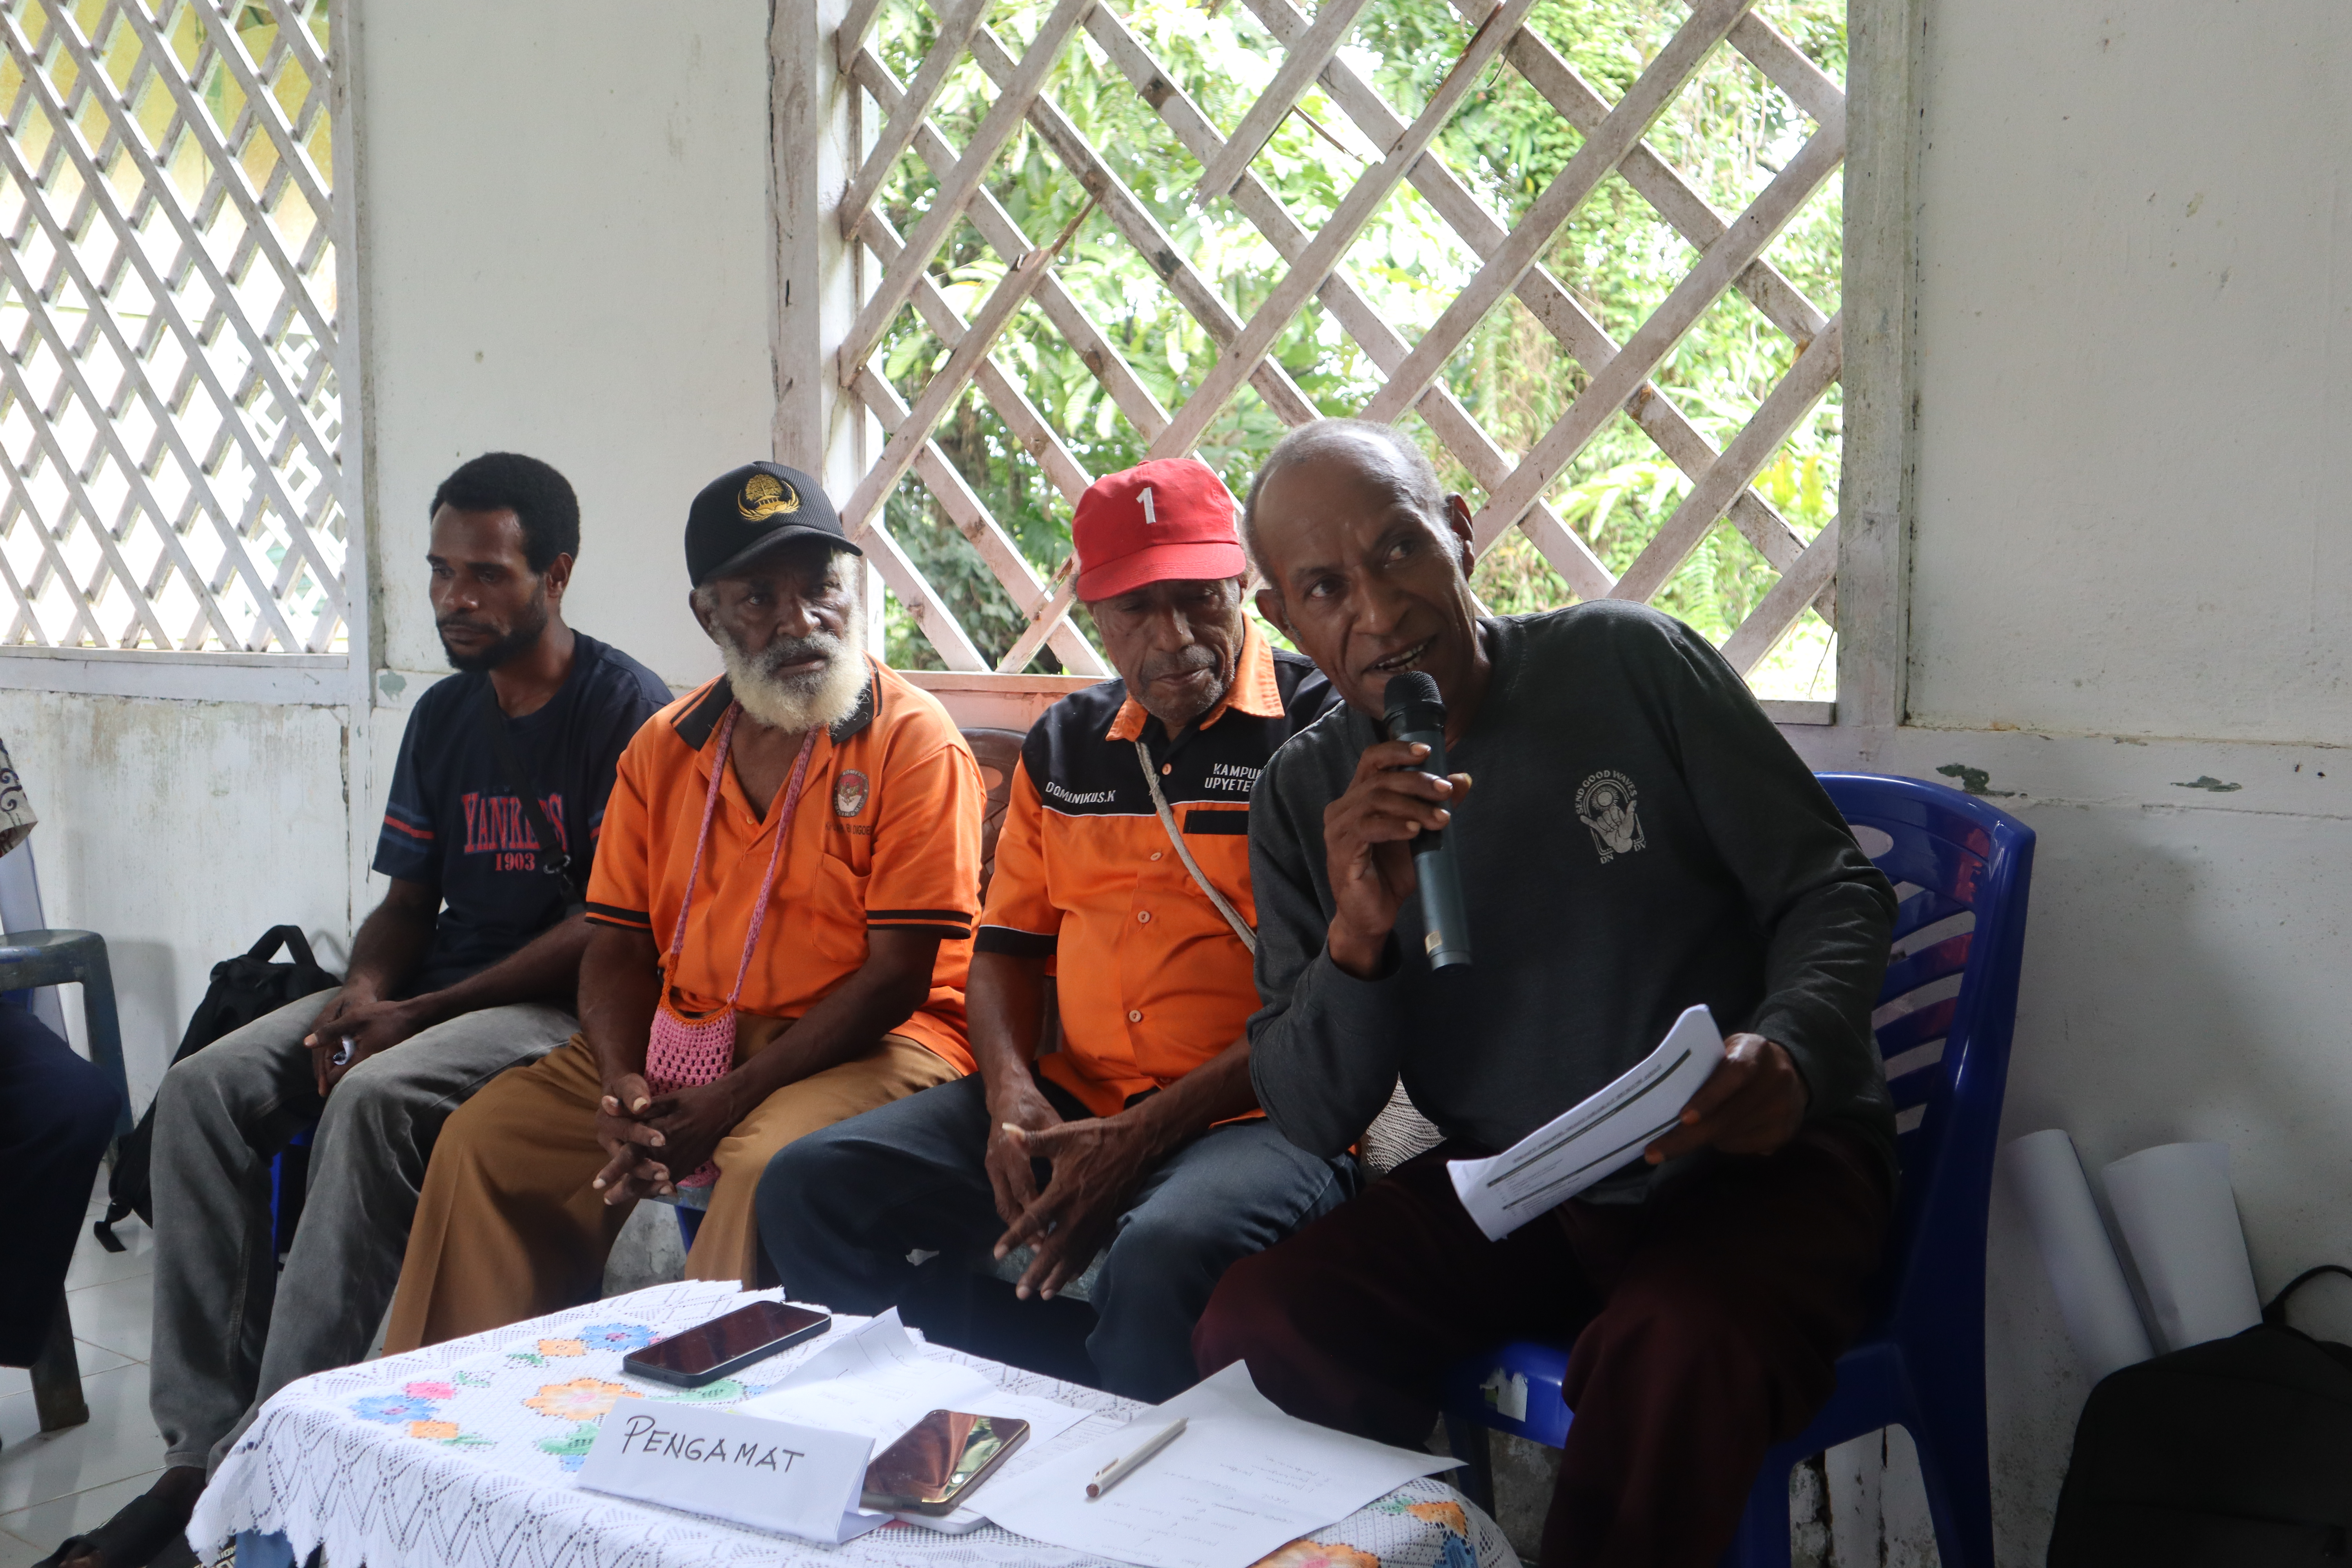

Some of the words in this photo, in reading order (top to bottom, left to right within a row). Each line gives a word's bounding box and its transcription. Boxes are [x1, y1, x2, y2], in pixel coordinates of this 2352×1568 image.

[1136, 486, 1156, 524] 1
[1045, 781, 1116, 804] DOMINIKUS.K
[1204, 777, 1255, 792] UPYETE
[1575, 788, 1585, 815] SEND
[1582, 770, 1611, 788] GOOD
[1613, 770, 1638, 797] WAVES
[461, 792, 567, 855] YANKS
[853, 824, 871, 835] DIGOE
[495, 853, 535, 871] 1903
[622, 1415, 805, 1473] PENGAMAT
